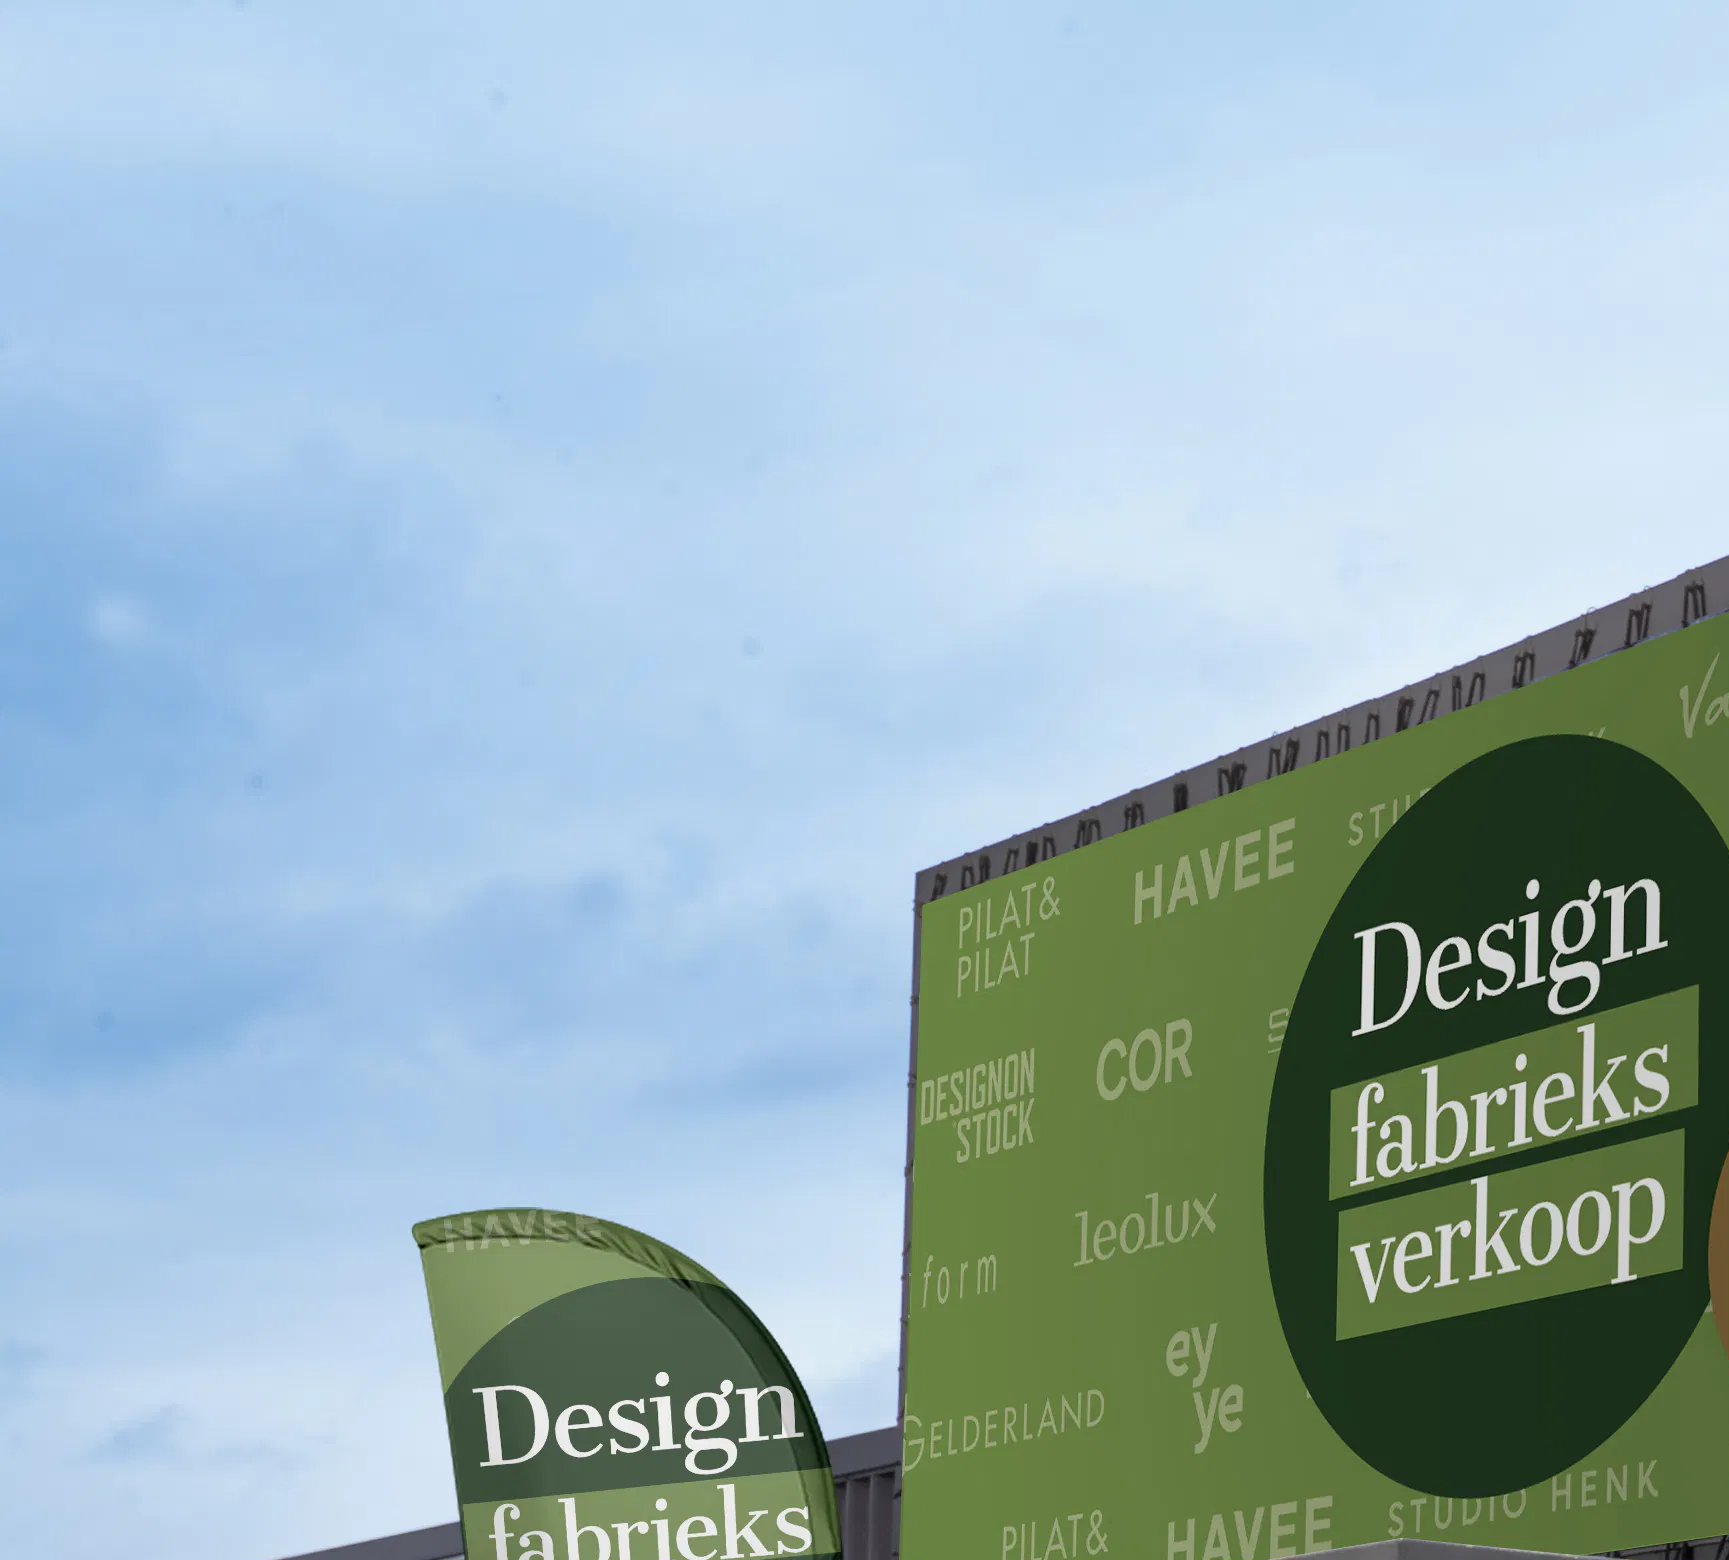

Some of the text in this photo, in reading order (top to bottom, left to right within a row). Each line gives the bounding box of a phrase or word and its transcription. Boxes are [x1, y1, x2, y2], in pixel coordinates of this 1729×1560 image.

[1134, 818, 1296, 924] HAVEE
[959, 875, 1060, 949] PILAT&
[957, 933, 1033, 997] PILAT
[1352, 878, 1669, 1038] Design
[921, 1049, 1035, 1126] DESIGNON
[1097, 1018, 1193, 1101] COR
[955, 1100, 1034, 1163] STOCK
[1350, 1025, 1671, 1188] fabrieks
[1074, 1194, 1218, 1267] leolux
[1350, 1177, 1666, 1304] verkoop
[1165, 1322, 1218, 1388] ey
[472, 1372, 804, 1475] Design
[903, 1389, 1105, 1472] GELDERLAND
[1193, 1383, 1244, 1454] ye
[1388, 1461, 1659, 1539] STUDIO HENK
